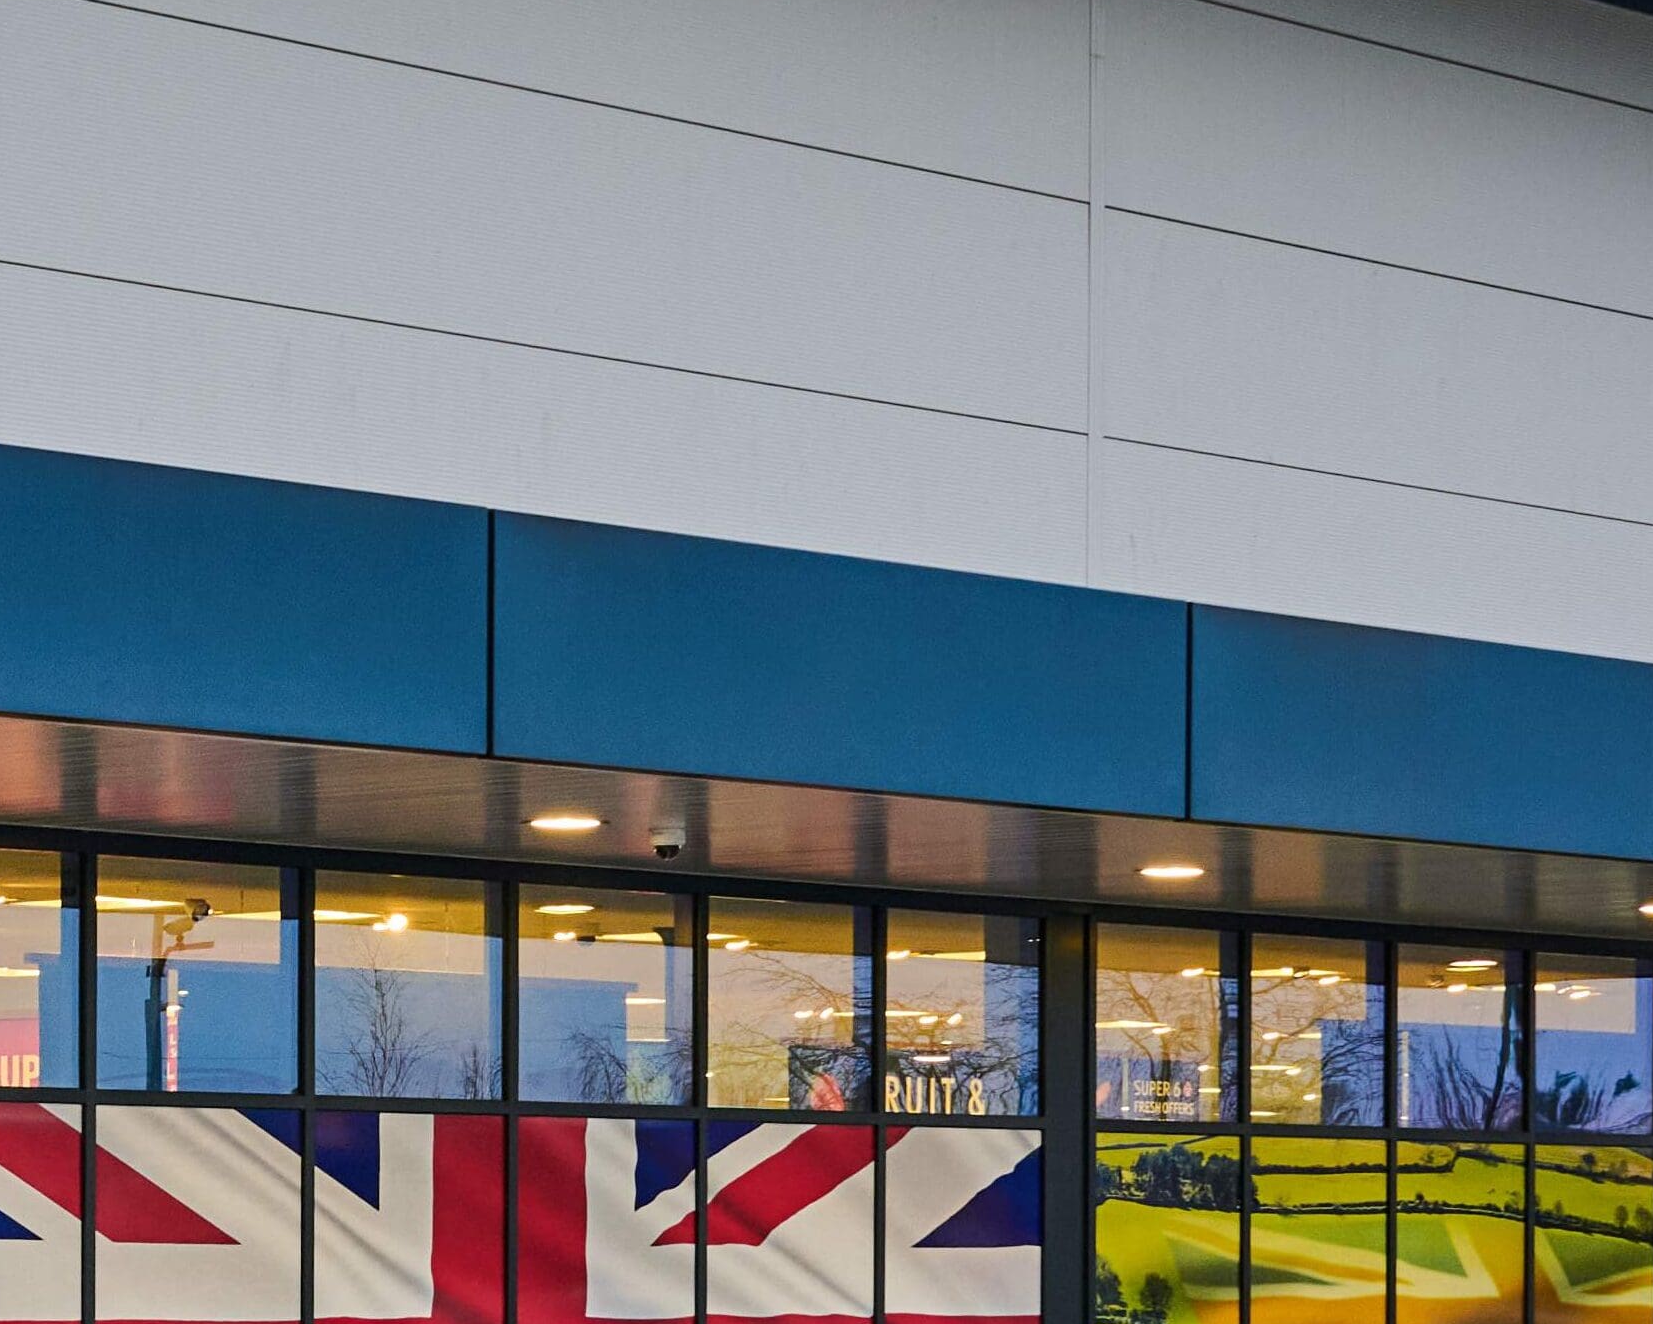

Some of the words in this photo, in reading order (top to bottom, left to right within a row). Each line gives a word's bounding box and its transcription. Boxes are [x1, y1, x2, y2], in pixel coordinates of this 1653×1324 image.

[885, 1075, 955, 1115] RUIT
[968, 1078, 986, 1116] &
[1133, 1079, 1171, 1097] SUPER
[1173, 1082, 1182, 1098] 6
